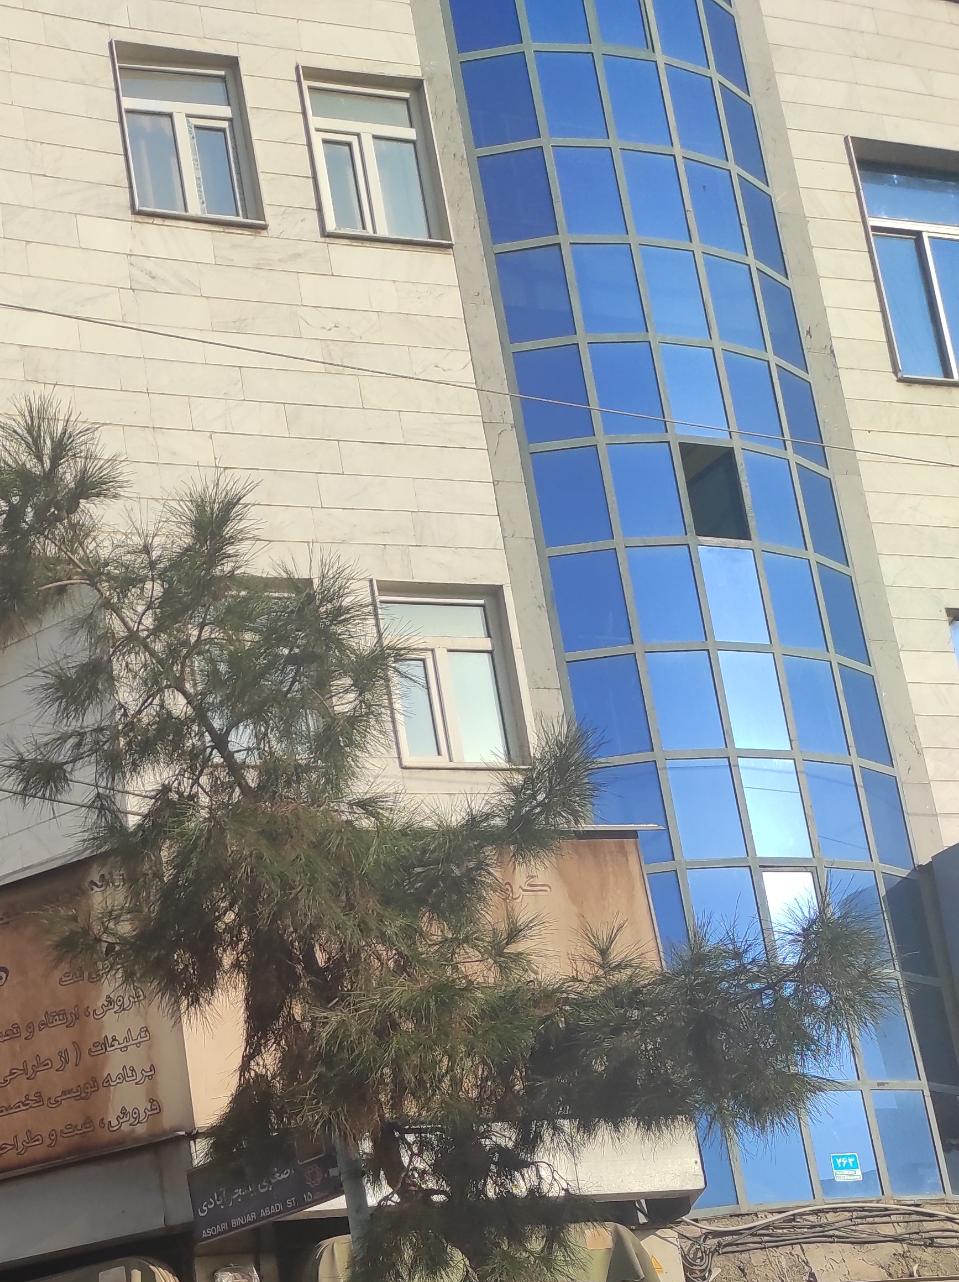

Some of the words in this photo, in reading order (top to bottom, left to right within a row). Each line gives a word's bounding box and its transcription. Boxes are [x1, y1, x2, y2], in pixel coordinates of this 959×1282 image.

[24, 1020, 35, 1040] و
[88, 1024, 151, 1058] تبلیغات
[102, 1063, 156, 1088] برنامه
[47, 1076, 99, 1109] نویسی
[47, 1129, 58, 1148] و
[260, 1203, 283, 1218] ABADI
